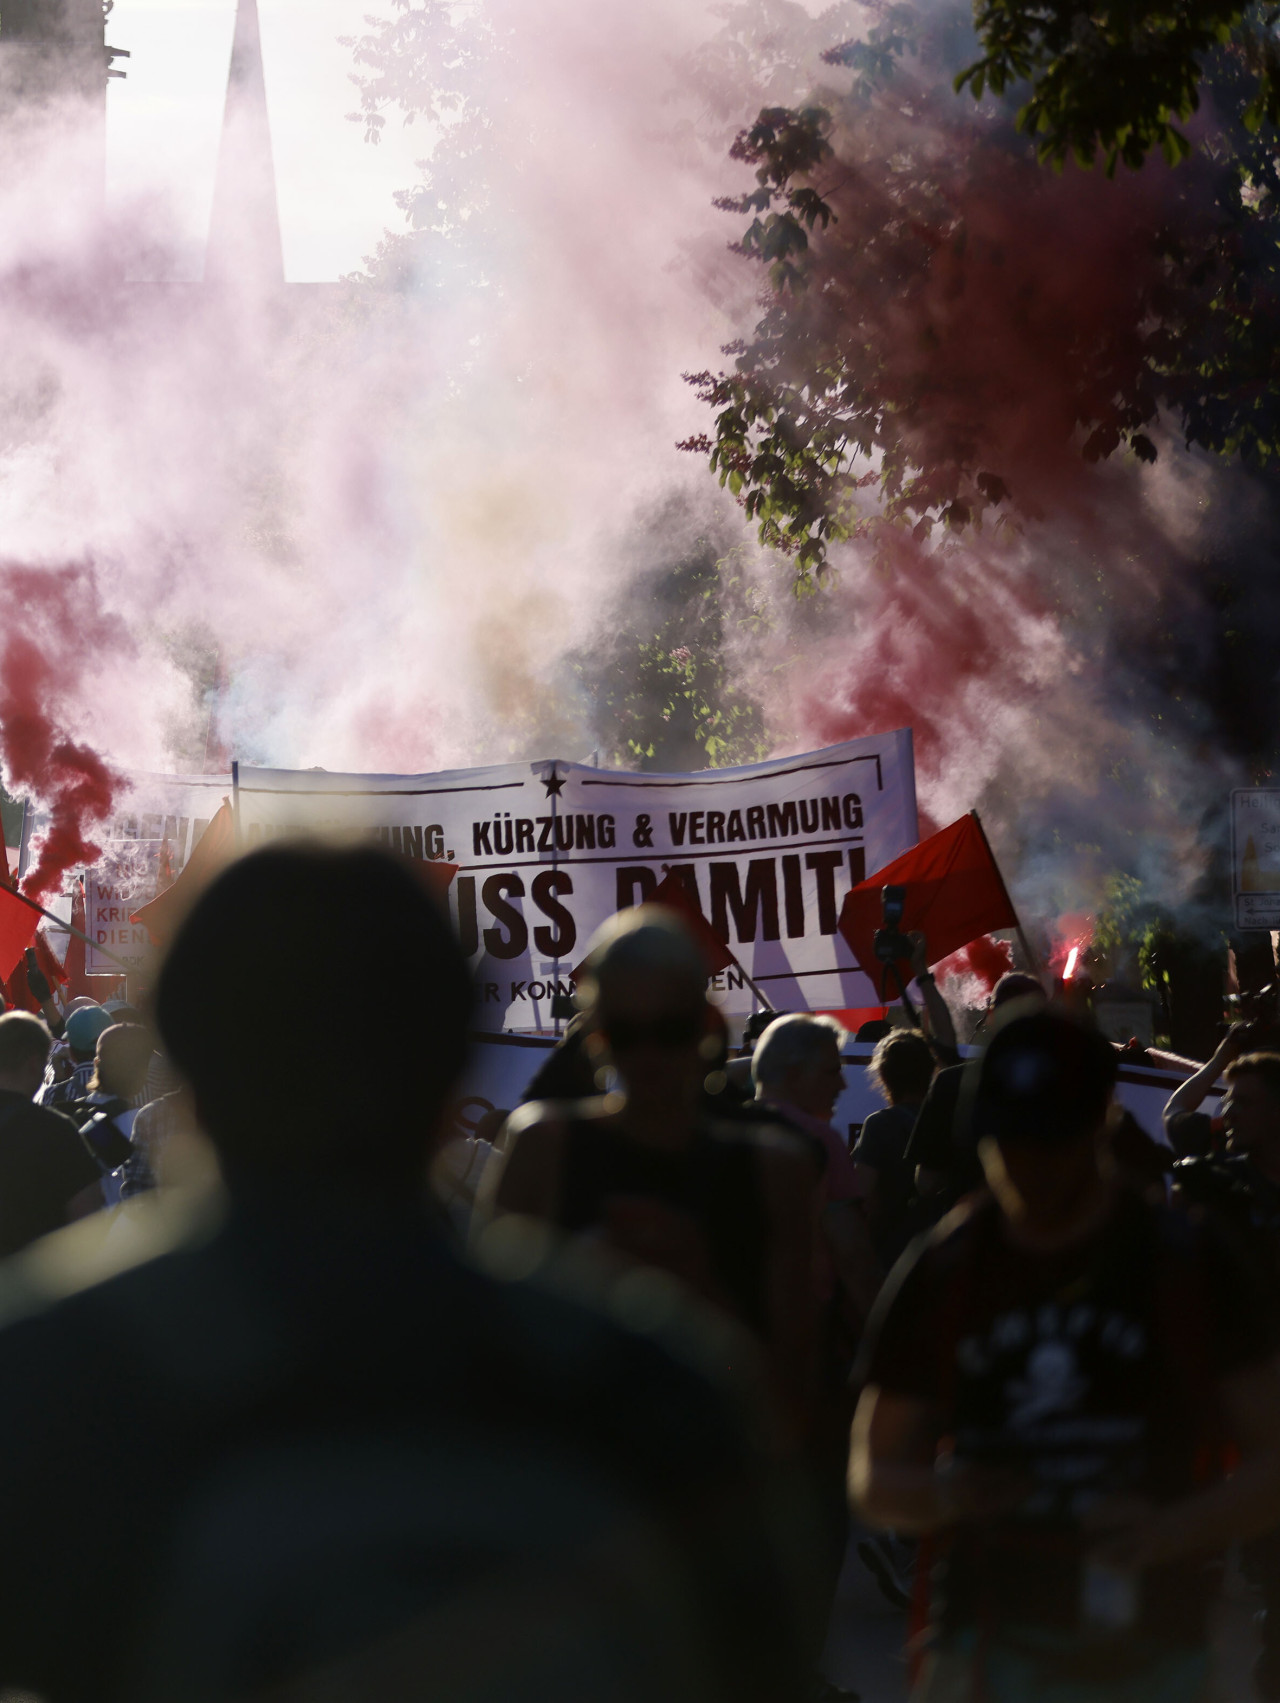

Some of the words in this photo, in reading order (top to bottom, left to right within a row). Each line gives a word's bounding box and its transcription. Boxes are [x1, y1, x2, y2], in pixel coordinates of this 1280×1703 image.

[473, 812, 616, 857] KÜRZUNG
[632, 813, 654, 848] &
[669, 793, 864, 847] VERARMUNG
[97, 929, 150, 944] DIEN
